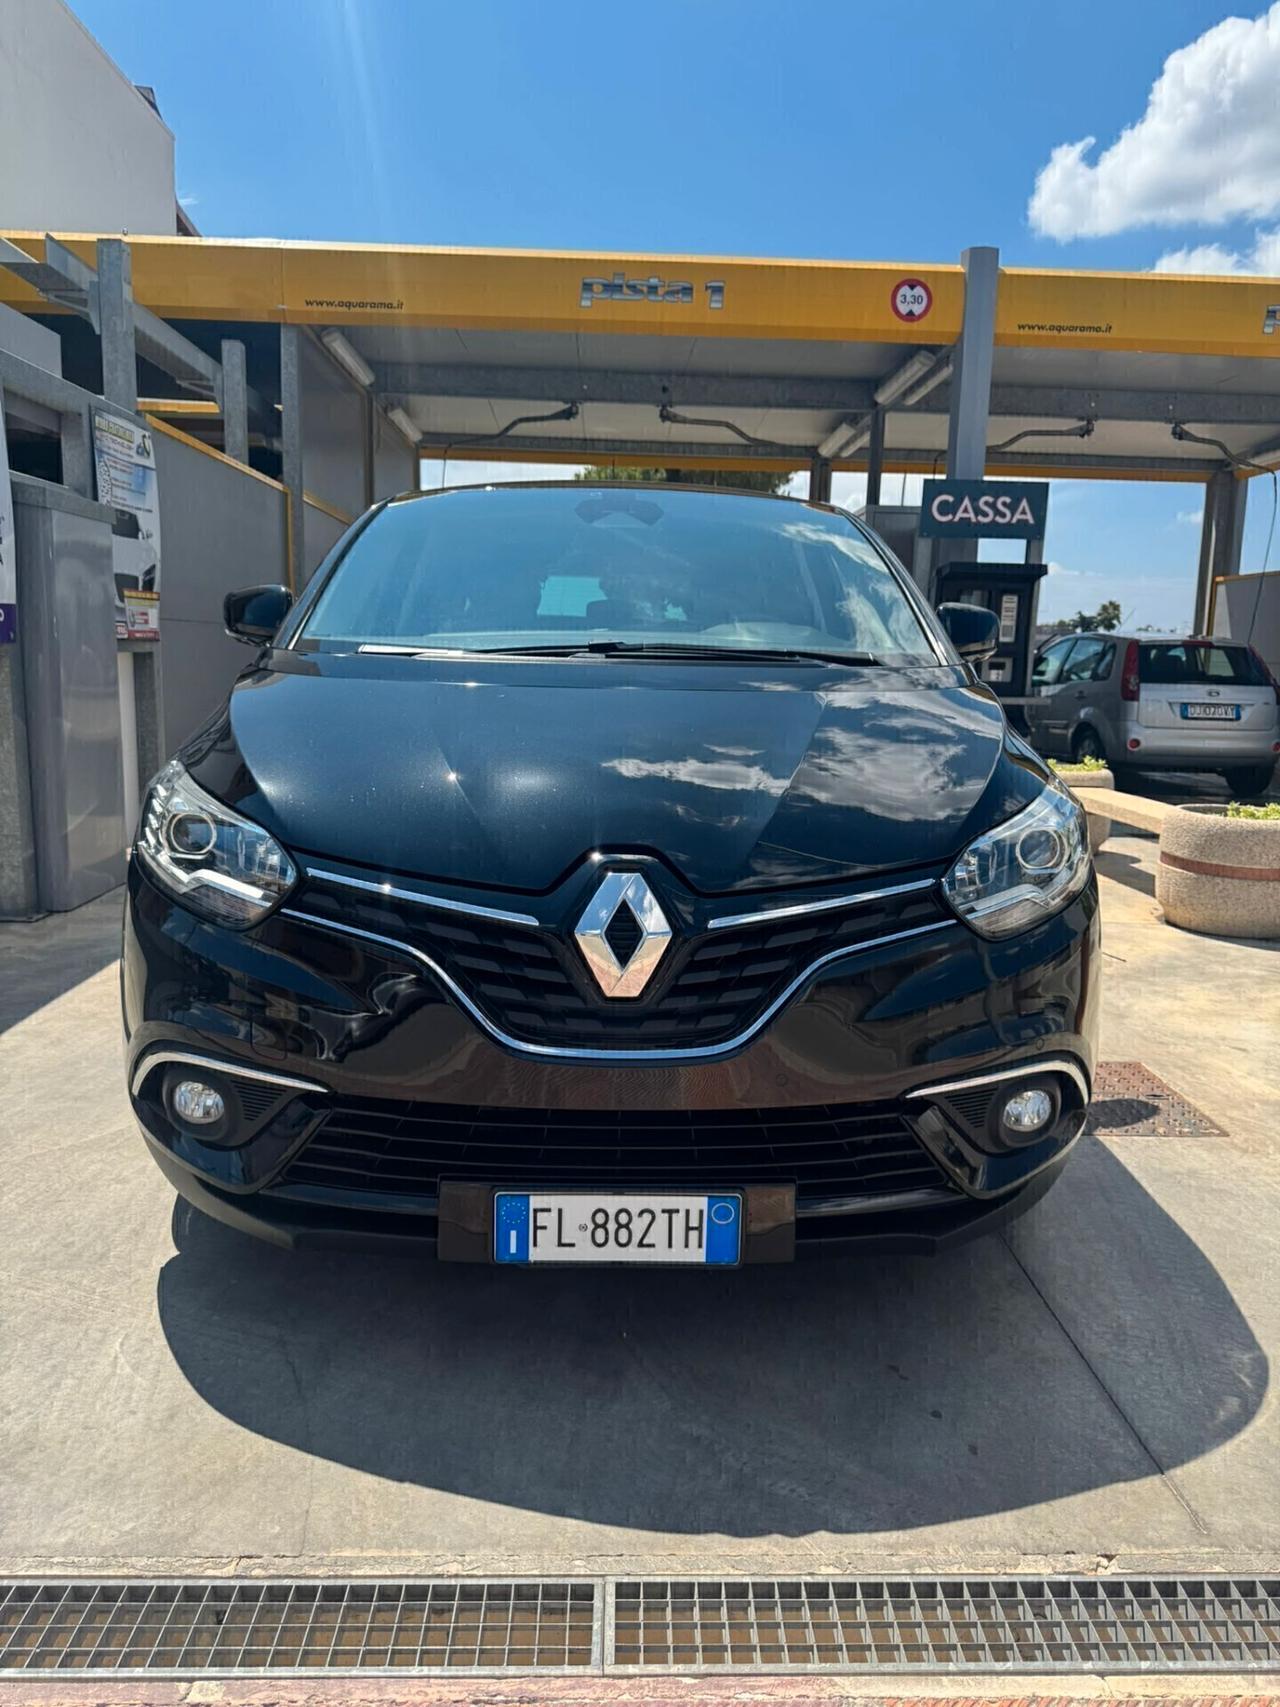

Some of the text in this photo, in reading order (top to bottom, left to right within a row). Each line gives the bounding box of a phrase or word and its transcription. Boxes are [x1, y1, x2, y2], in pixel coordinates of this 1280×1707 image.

[580, 272, 726, 309] pista 1
[305, 298, 404, 310] www.aquarama.it
[900, 293, 924, 305] 3,30
[1017, 322, 1113, 334] www.aquarama.it
[931, 494, 1035, 525] CASSA
